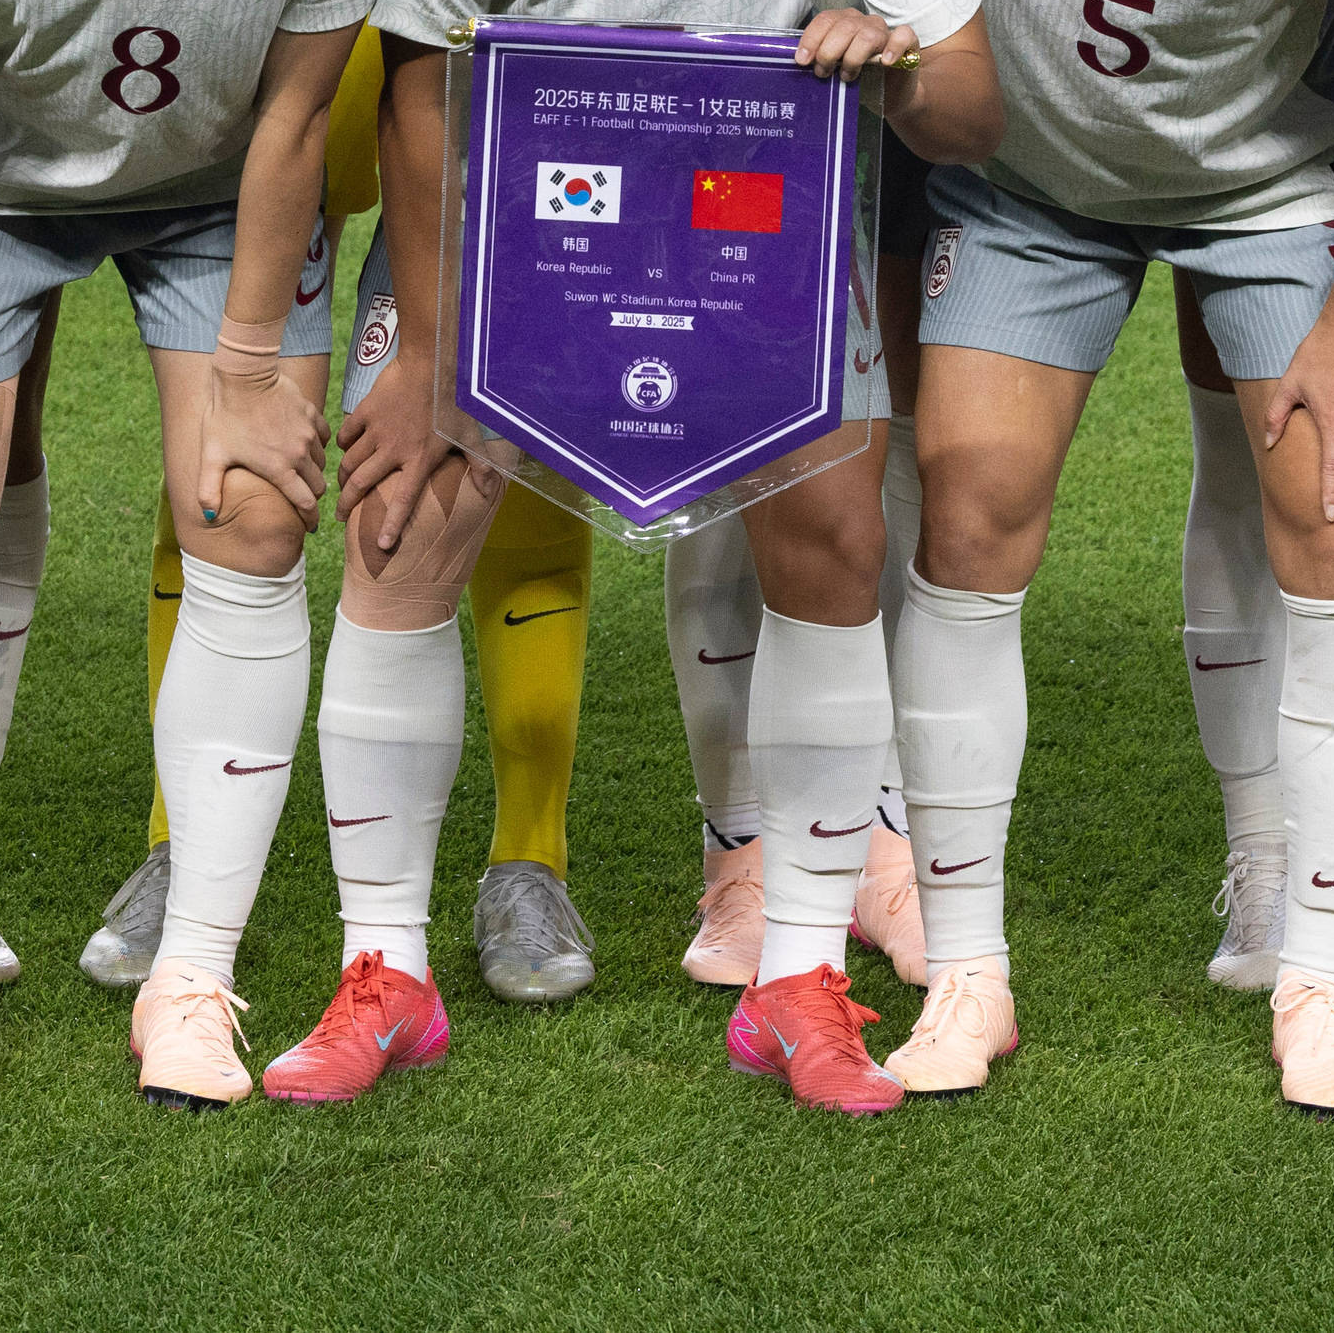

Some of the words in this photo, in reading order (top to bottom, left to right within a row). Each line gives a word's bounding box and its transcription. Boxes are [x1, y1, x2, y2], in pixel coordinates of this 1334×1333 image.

[101, 26, 182, 116] 8
[533, 113, 560, 125] EAFF
[563, 114, 587, 127] E-1
[591, 117, 635, 130] Football
[639, 119, 712, 136] Championship
[716, 124, 741, 136] 2025
[745, 125, 794, 138] Women's
[562, 237, 589, 253] 韩国
[721, 245, 748, 261] 中国
[536, 261, 565, 273] Korea
[569, 262, 613, 276] Republic
[647, 268, 663, 279] VS
[710, 271, 739, 283] China
[742, 274, 756, 284] PR
[564, 291, 598, 303] Suwon
[602, 293, 618, 304] WC
[700, 298, 744, 312] Republic
[618, 314, 642, 328] July
[661, 316, 686, 328] 2025
[641, 390, 657, 398] CFA
